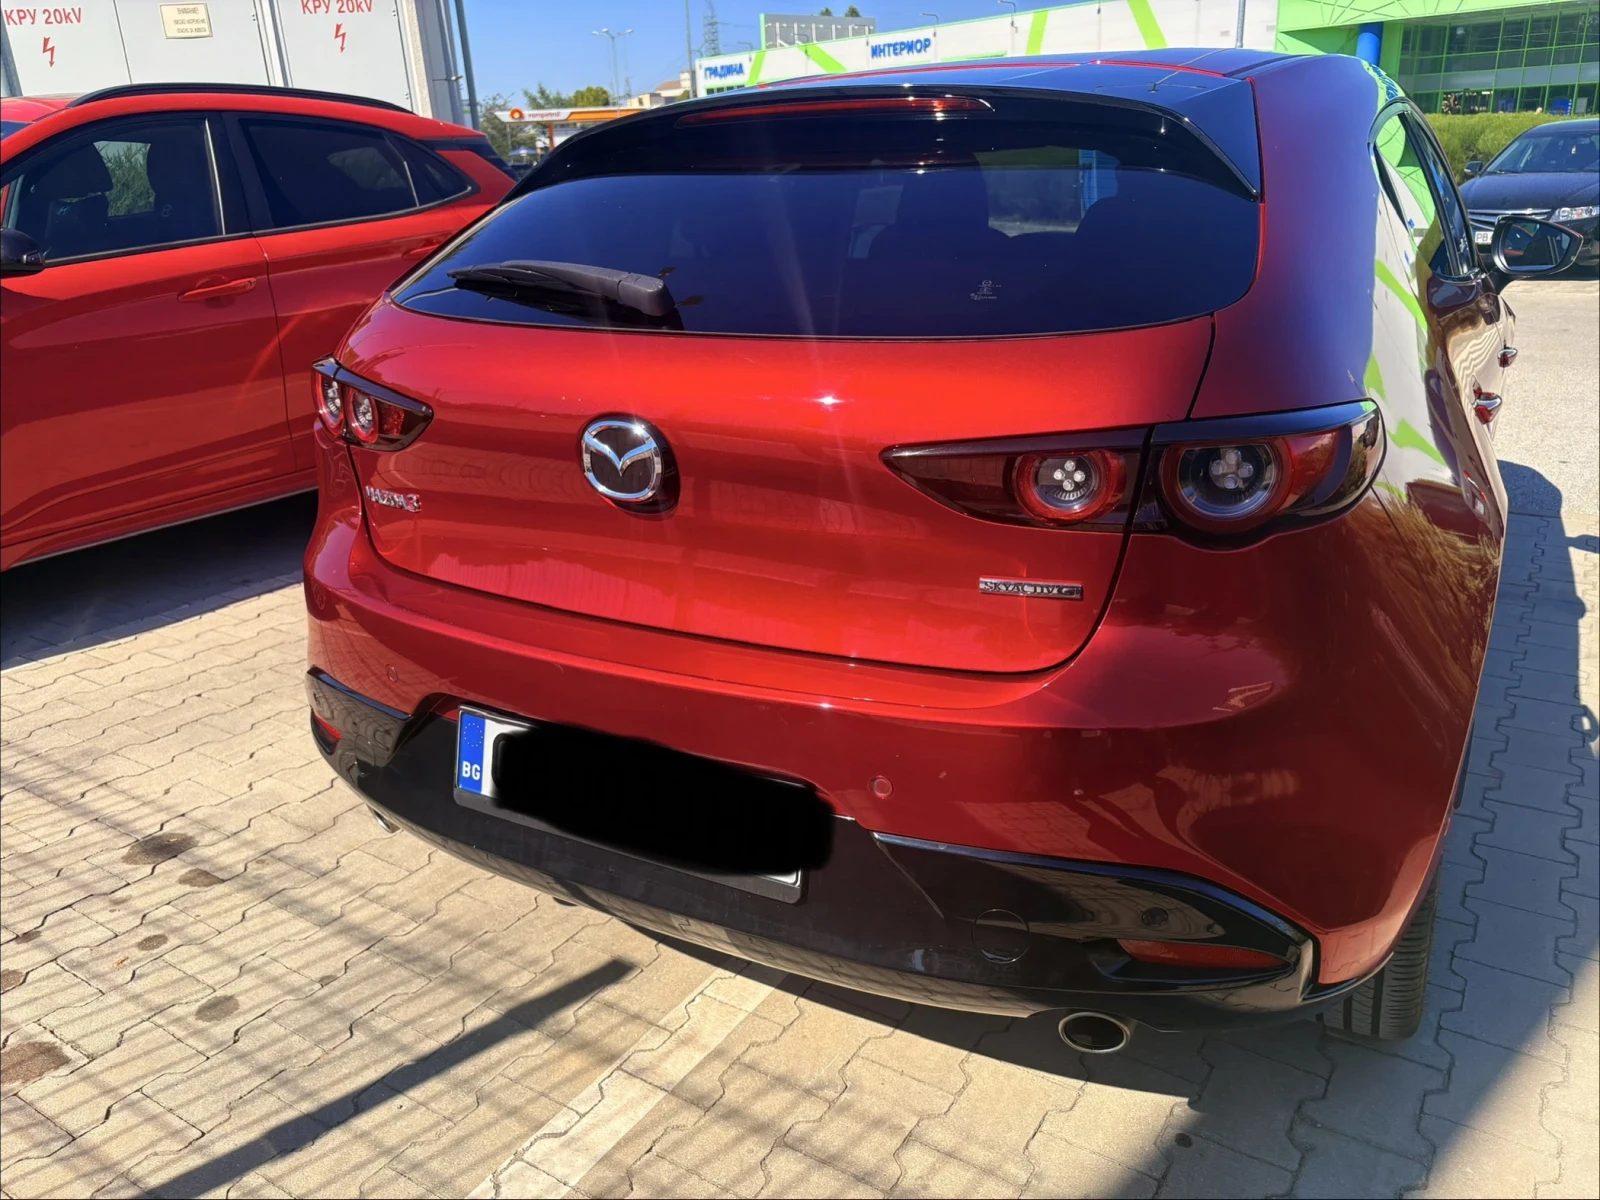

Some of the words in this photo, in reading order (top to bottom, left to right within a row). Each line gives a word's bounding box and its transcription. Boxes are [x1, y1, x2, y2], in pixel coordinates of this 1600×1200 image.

[4, 9, 36, 25] КРУ
[42, 7, 82, 24] 20kV
[301, 0, 331, 14] КРУ
[336, 0, 373, 13] 20kV
[870, 38, 931, 59] ИНТЕРИОР
[704, 62, 745, 80] ГРАДИНА
[462, 761, 481, 781] BG
